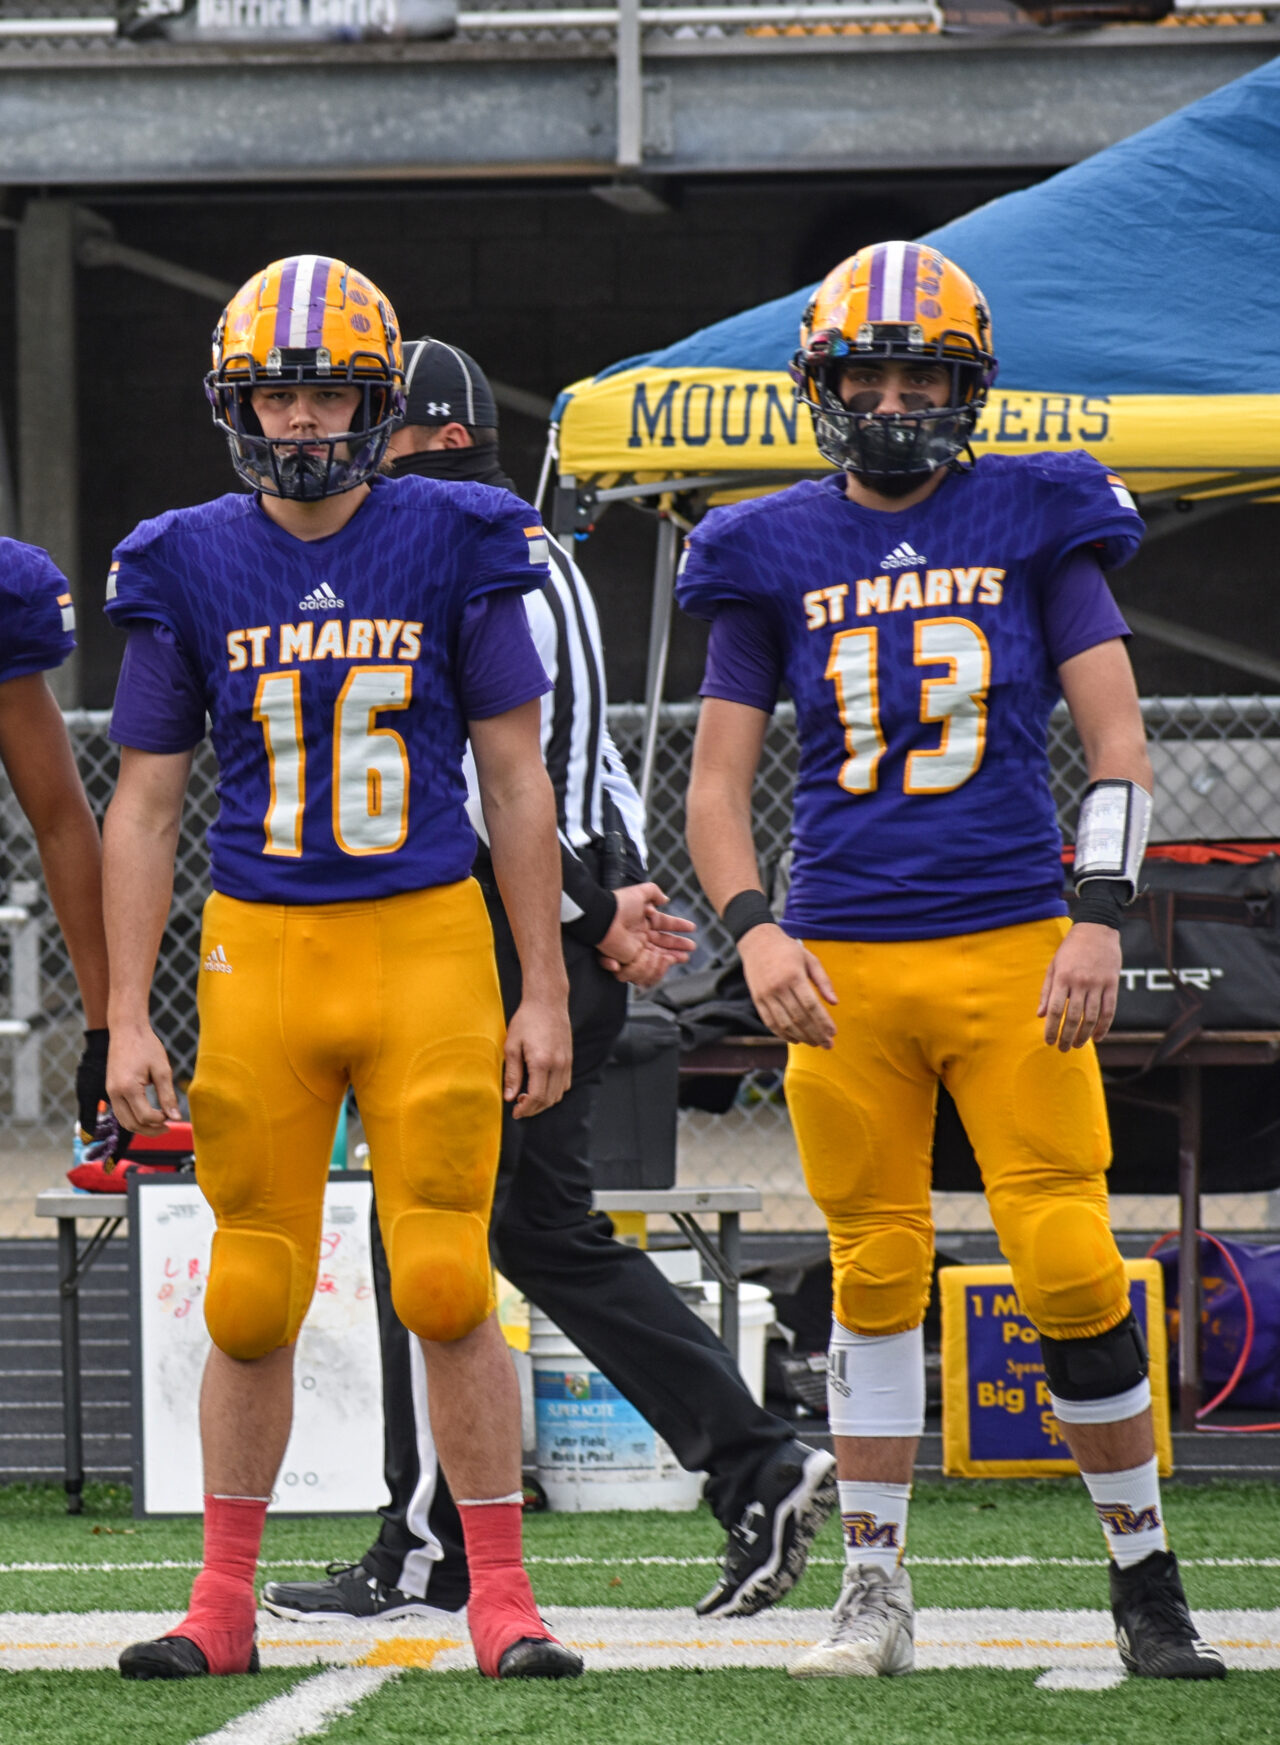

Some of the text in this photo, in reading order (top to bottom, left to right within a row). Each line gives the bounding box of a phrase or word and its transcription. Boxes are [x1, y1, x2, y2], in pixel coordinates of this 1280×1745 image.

[880, 555, 927, 569] adidas
[299, 599, 345, 611] adidas
[803, 567, 1006, 631] ST MARYS
[227, 619, 424, 672] ST MARYS
[824, 616, 992, 795] 13
[252, 665, 412, 858] 16
[971, 1294, 1024, 1317] 1 M
[1003, 1322, 1039, 1344] Po
[977, 1380, 1025, 1414] Big
